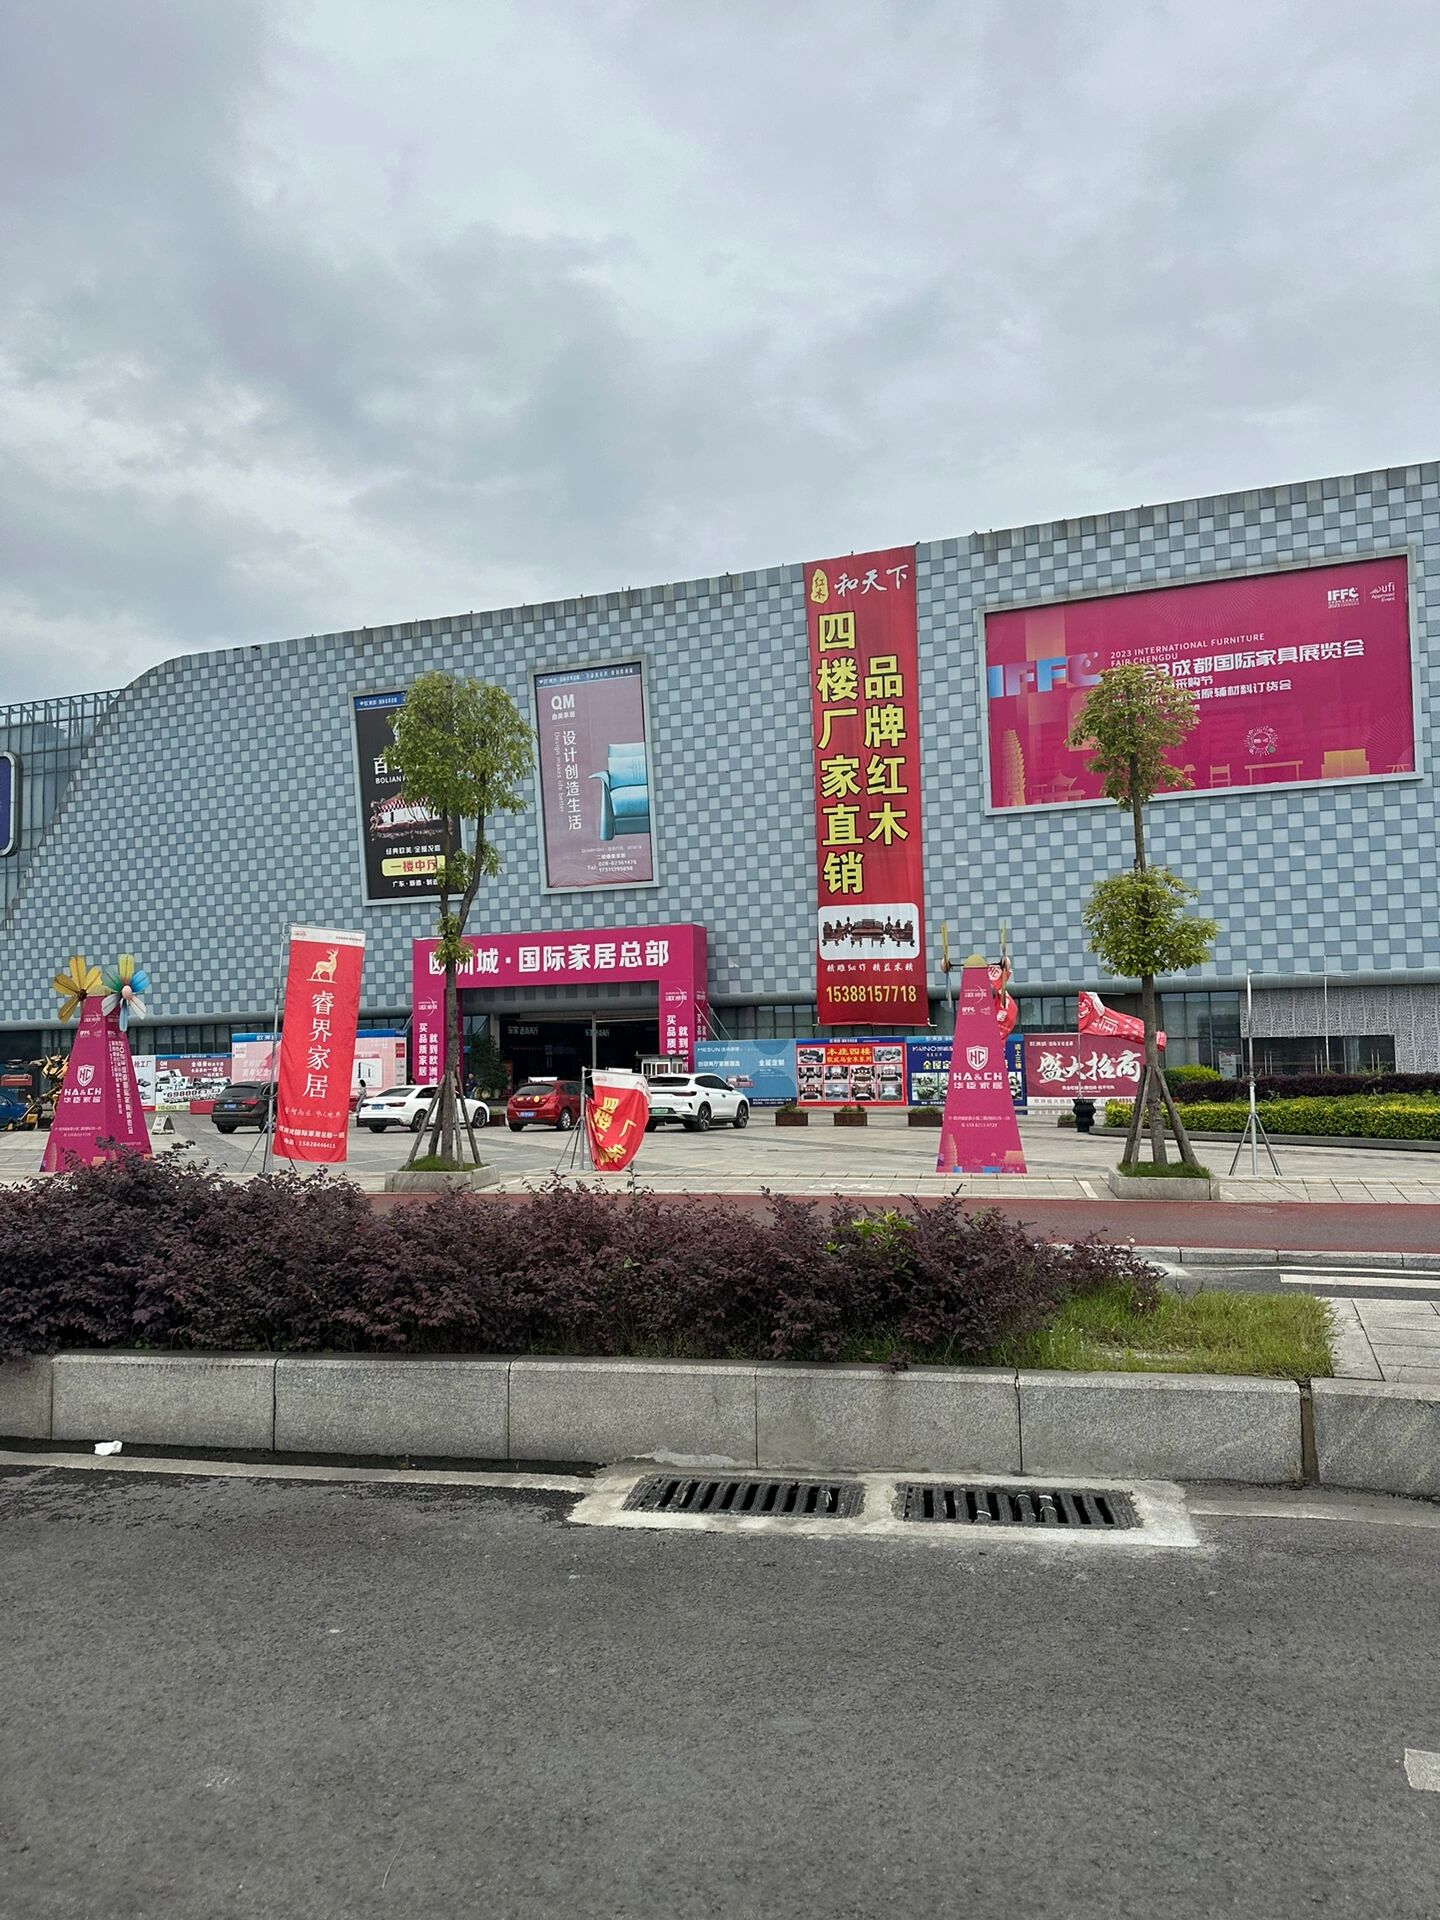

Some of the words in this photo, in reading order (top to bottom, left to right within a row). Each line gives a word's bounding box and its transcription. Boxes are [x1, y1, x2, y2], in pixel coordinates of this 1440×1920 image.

[833, 564, 909, 597] 和天下
[1110, 650, 1132, 659] 2023
[1134, 640, 1208, 655] INTERNATIONAL
[1211, 632, 1265, 646] FURNITURE
[1133, 653, 1178, 664] CHENGDU
[551, 693, 575, 710] QM
[816, 611, 865, 896] 四楼厂家直销
[863, 655, 909, 846] 品牌红木
[375, 776, 402, 785] BOLIAN
[562, 730, 582, 830] 设计创造生活
[826, 985, 917, 1003] 15388157718
[302, 989, 335, 1099] 睿界家居
[418, 1022, 428, 1077] 买品质家居
[970, 1050, 985, 1066] HC
[1037, 1049, 1142, 1084] 盛大招商
[79, 1068, 92, 1082] HC
[953, 1072, 1003, 1081] HA&CH
[64, 1087, 102, 1096] HA&CH
